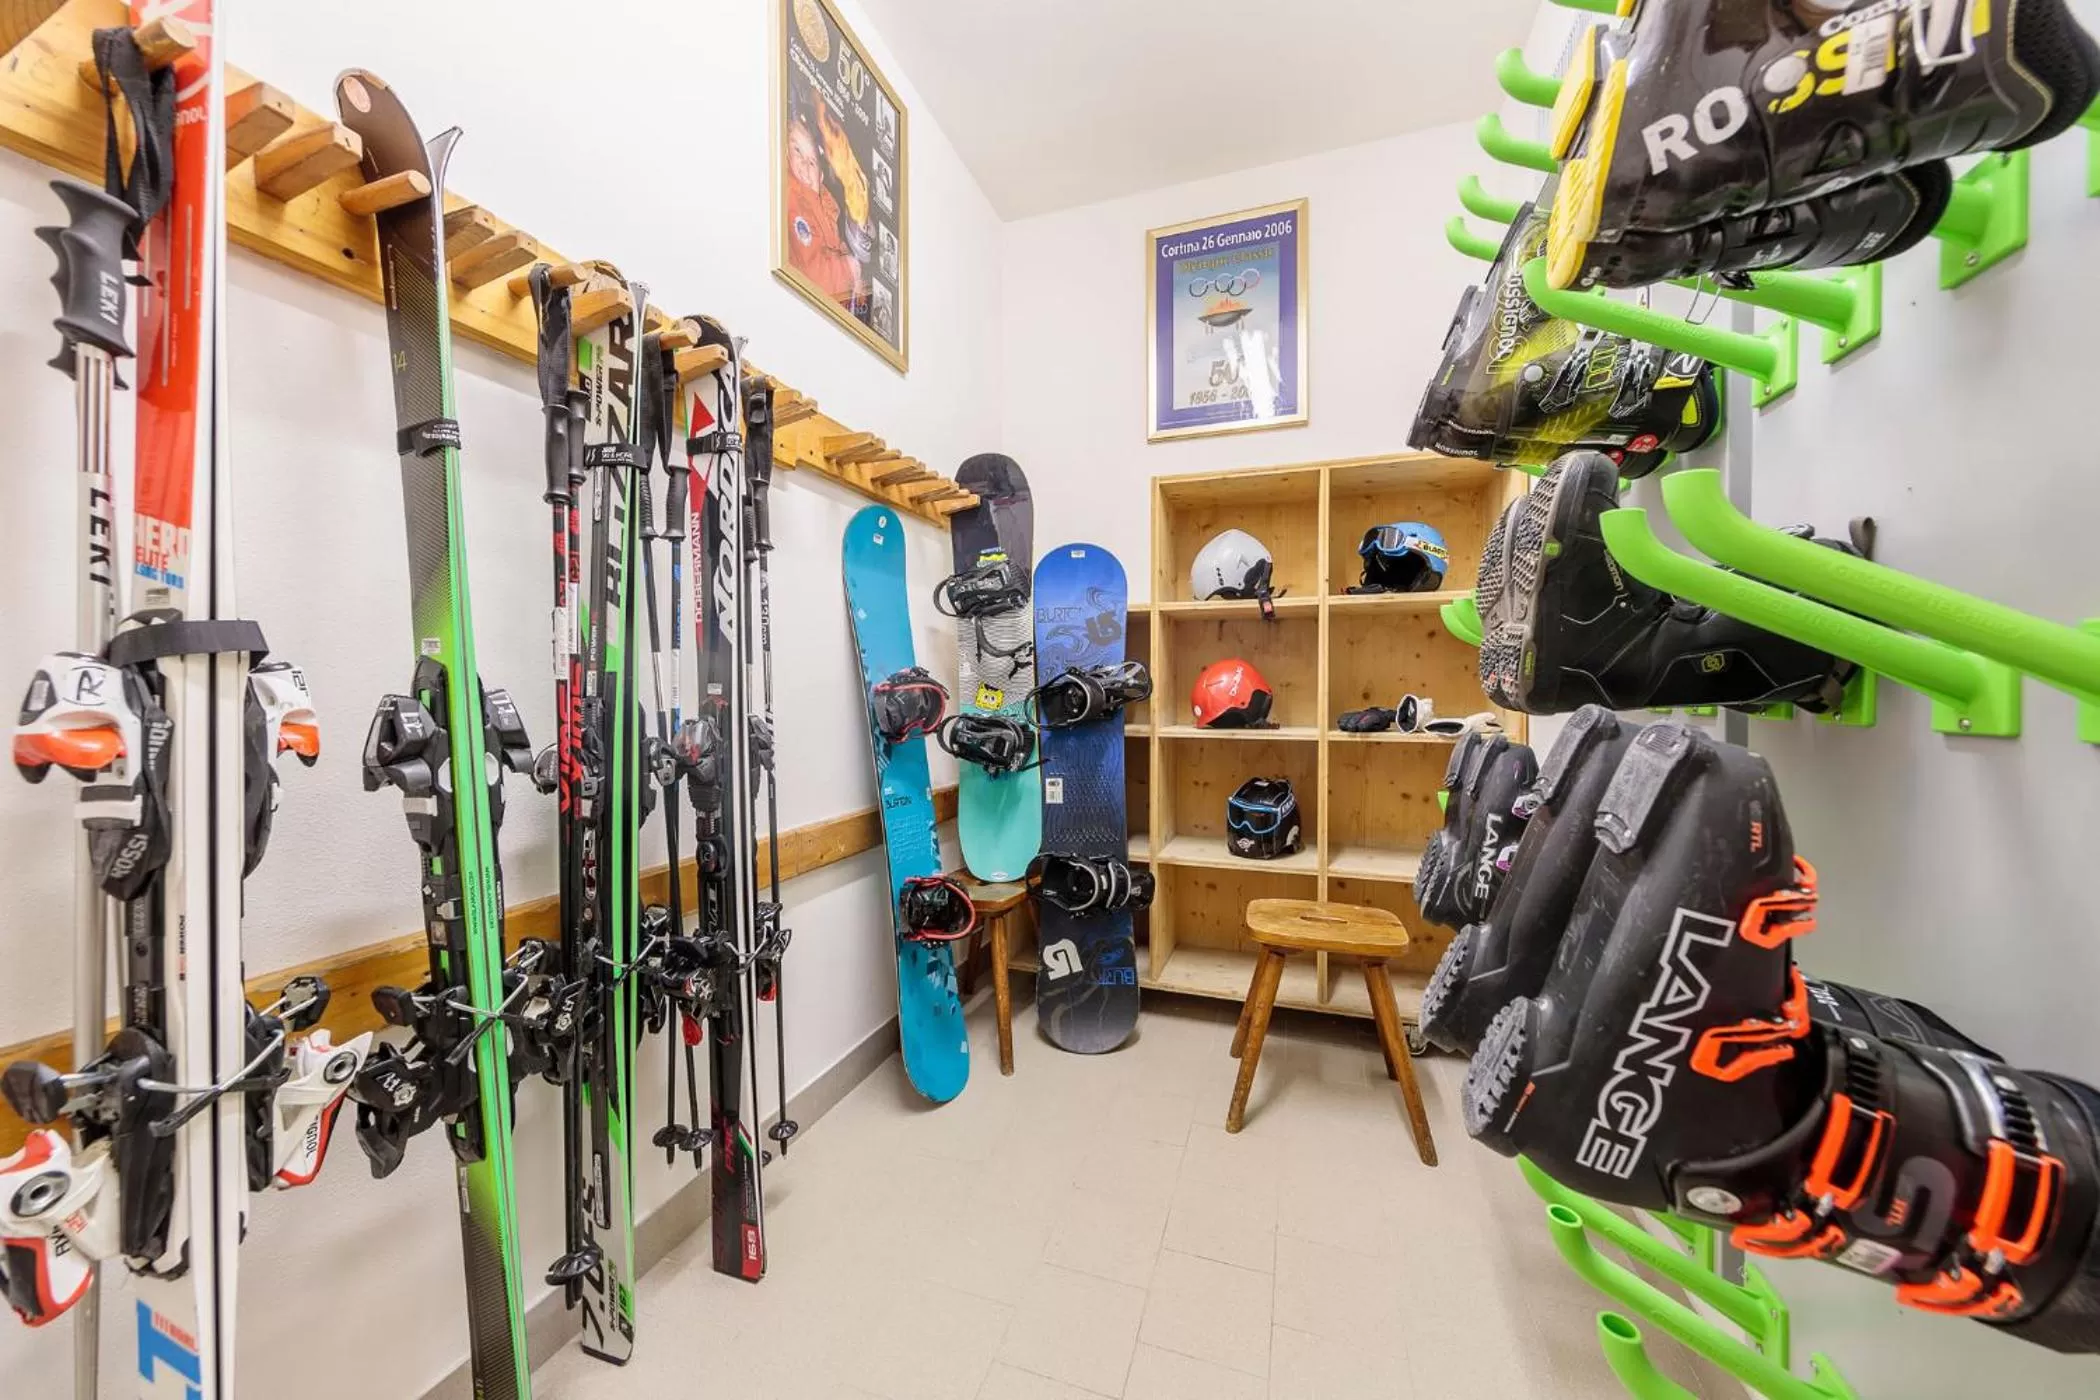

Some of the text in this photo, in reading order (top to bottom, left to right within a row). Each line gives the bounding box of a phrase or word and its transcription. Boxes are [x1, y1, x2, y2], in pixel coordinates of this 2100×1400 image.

[1161, 219, 1293, 258] Cortina 26 Gennaio 2006
[100, 270, 119, 326] LEKI
[605, 312, 637, 609] BLIZZAR
[89, 486, 111, 587] LEKI
[690, 512, 704, 624] DOBERMANN
[111, 833, 149, 879] ROSSI
[1474, 811, 1503, 899] LANGE
[1575, 906, 1737, 1180] LANGE
